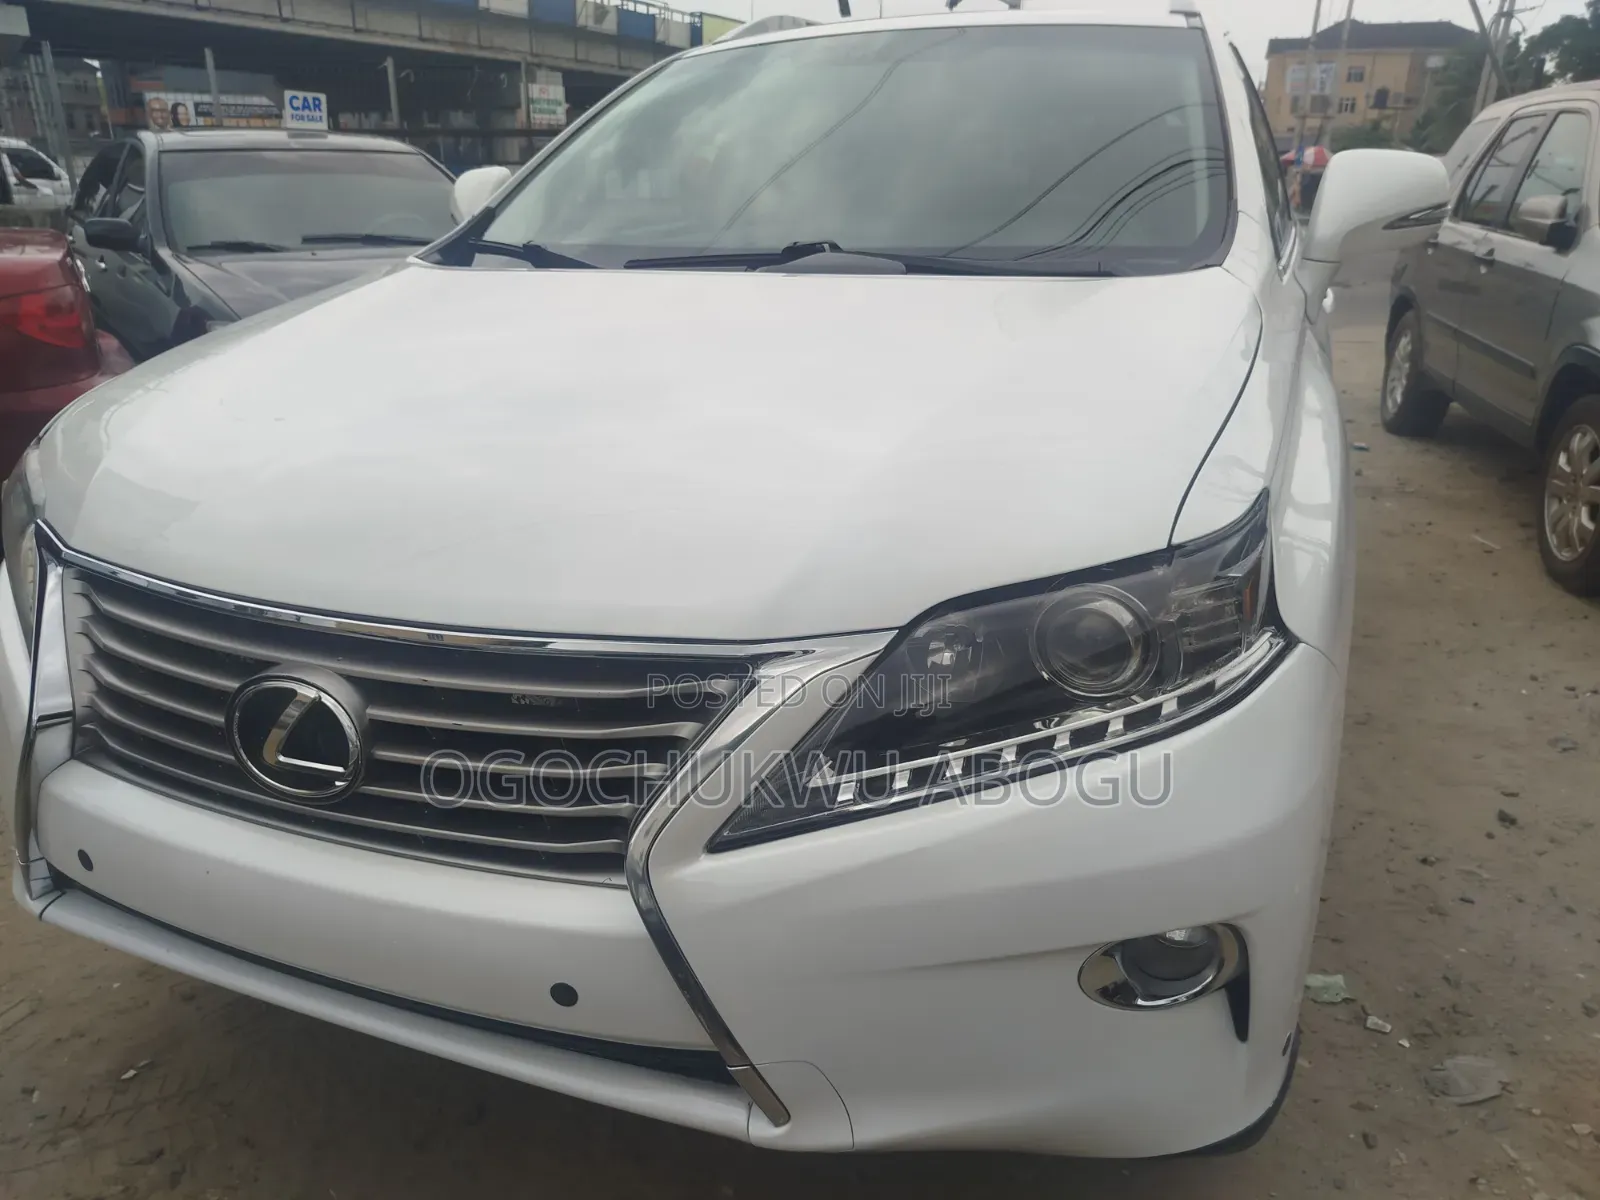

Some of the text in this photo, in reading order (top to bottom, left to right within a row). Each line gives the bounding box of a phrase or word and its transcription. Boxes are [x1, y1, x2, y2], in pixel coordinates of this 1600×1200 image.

[289, 95, 322, 112] CAR
[291, 113, 323, 123] FOR SALE
